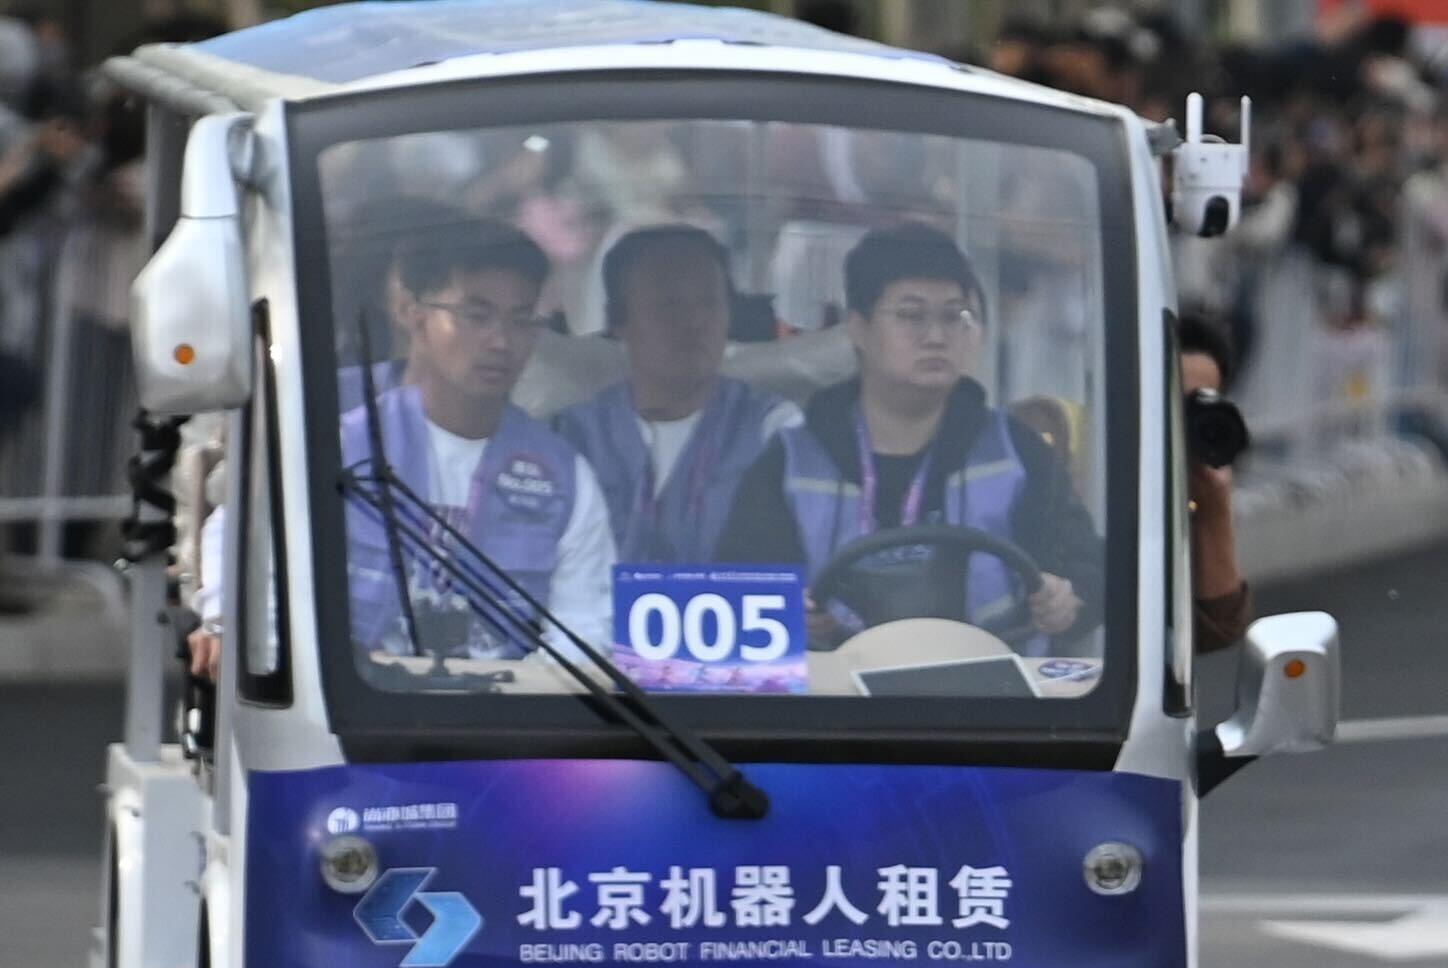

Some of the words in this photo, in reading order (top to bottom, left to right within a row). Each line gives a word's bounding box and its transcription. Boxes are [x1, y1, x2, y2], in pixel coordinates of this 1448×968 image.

[628, 593, 790, 662] 005
[517, 864, 1013, 930] 北京机器人租赁
[519, 943, 604, 962] BEIJING
[613, 942, 690, 961] ROBOT
[700, 940, 813, 960] FINANCIAL
[822, 938, 918, 959] LEASING
